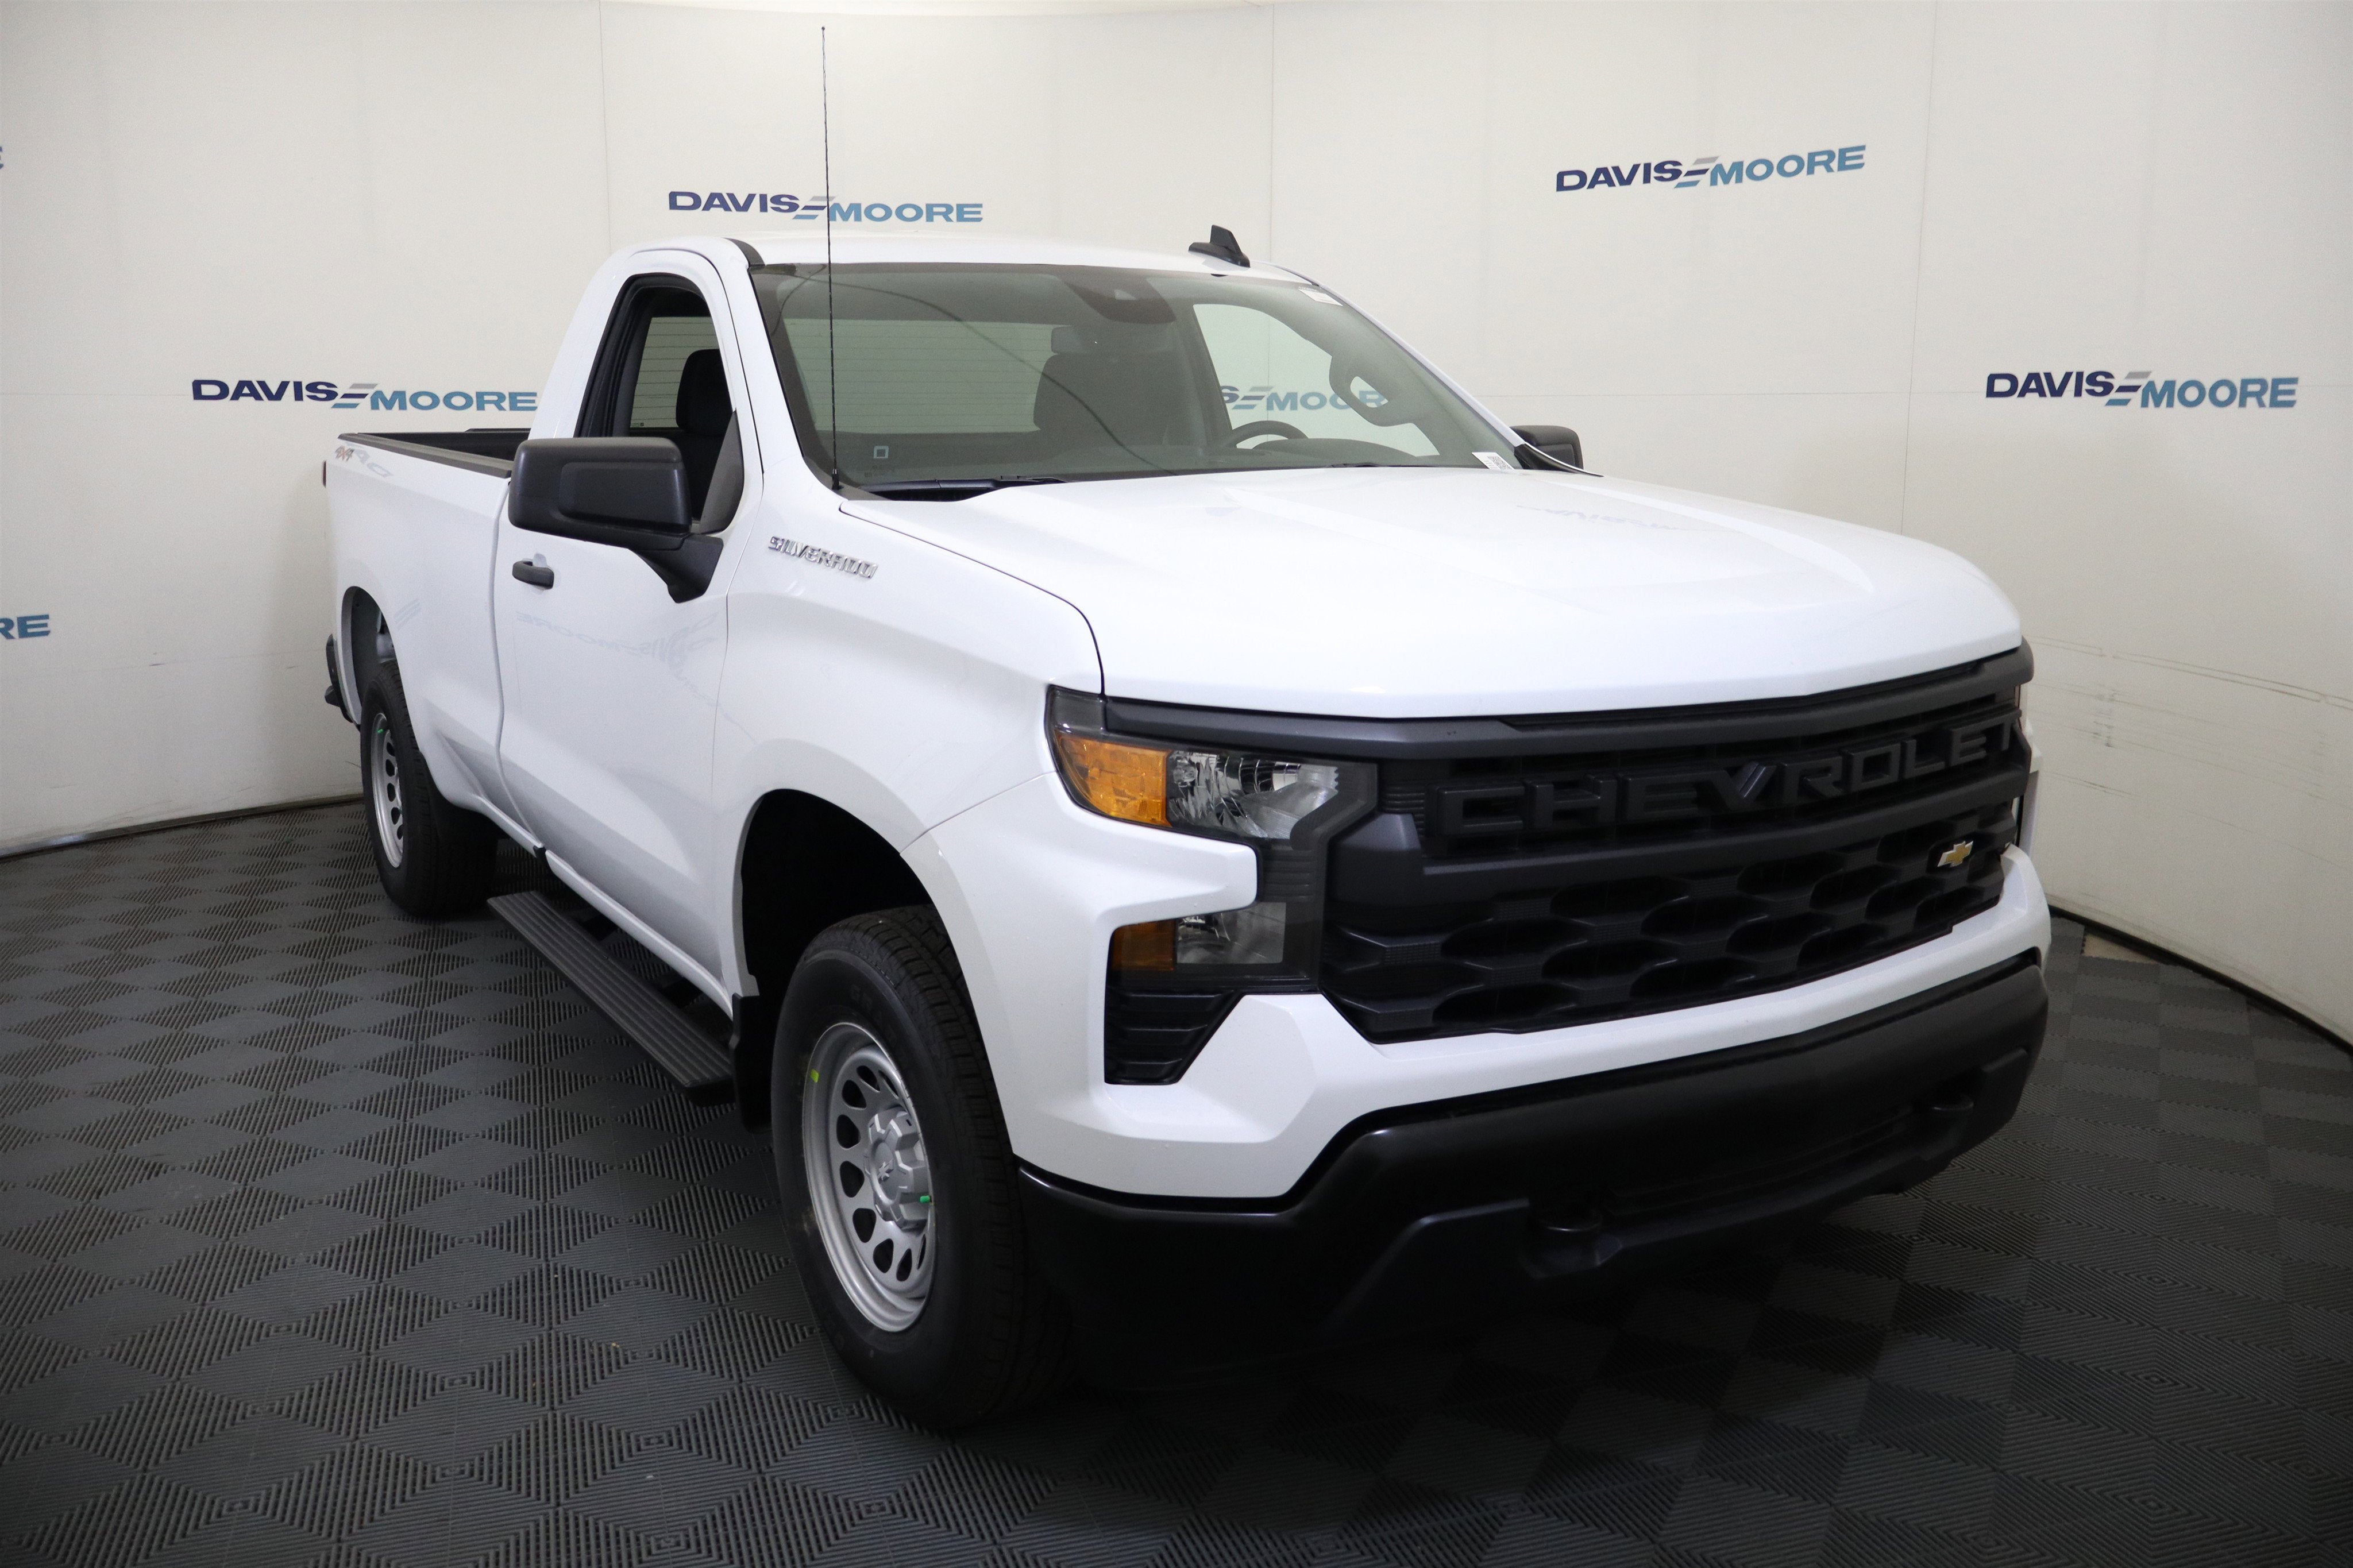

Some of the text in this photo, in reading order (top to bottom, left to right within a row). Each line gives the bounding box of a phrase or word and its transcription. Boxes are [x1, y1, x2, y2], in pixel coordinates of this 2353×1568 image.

[1556, 144, 1866, 192] DAVIS MOORE
[668, 191, 983, 223] DAVIS MOORE
[192, 379, 538, 412] DAVIS MOORE
[1985, 371, 2300, 408] DAVIS MOORE
[768, 536, 879, 580] SILVERADO
[1434, 709, 2022, 837] CHEVROLET
